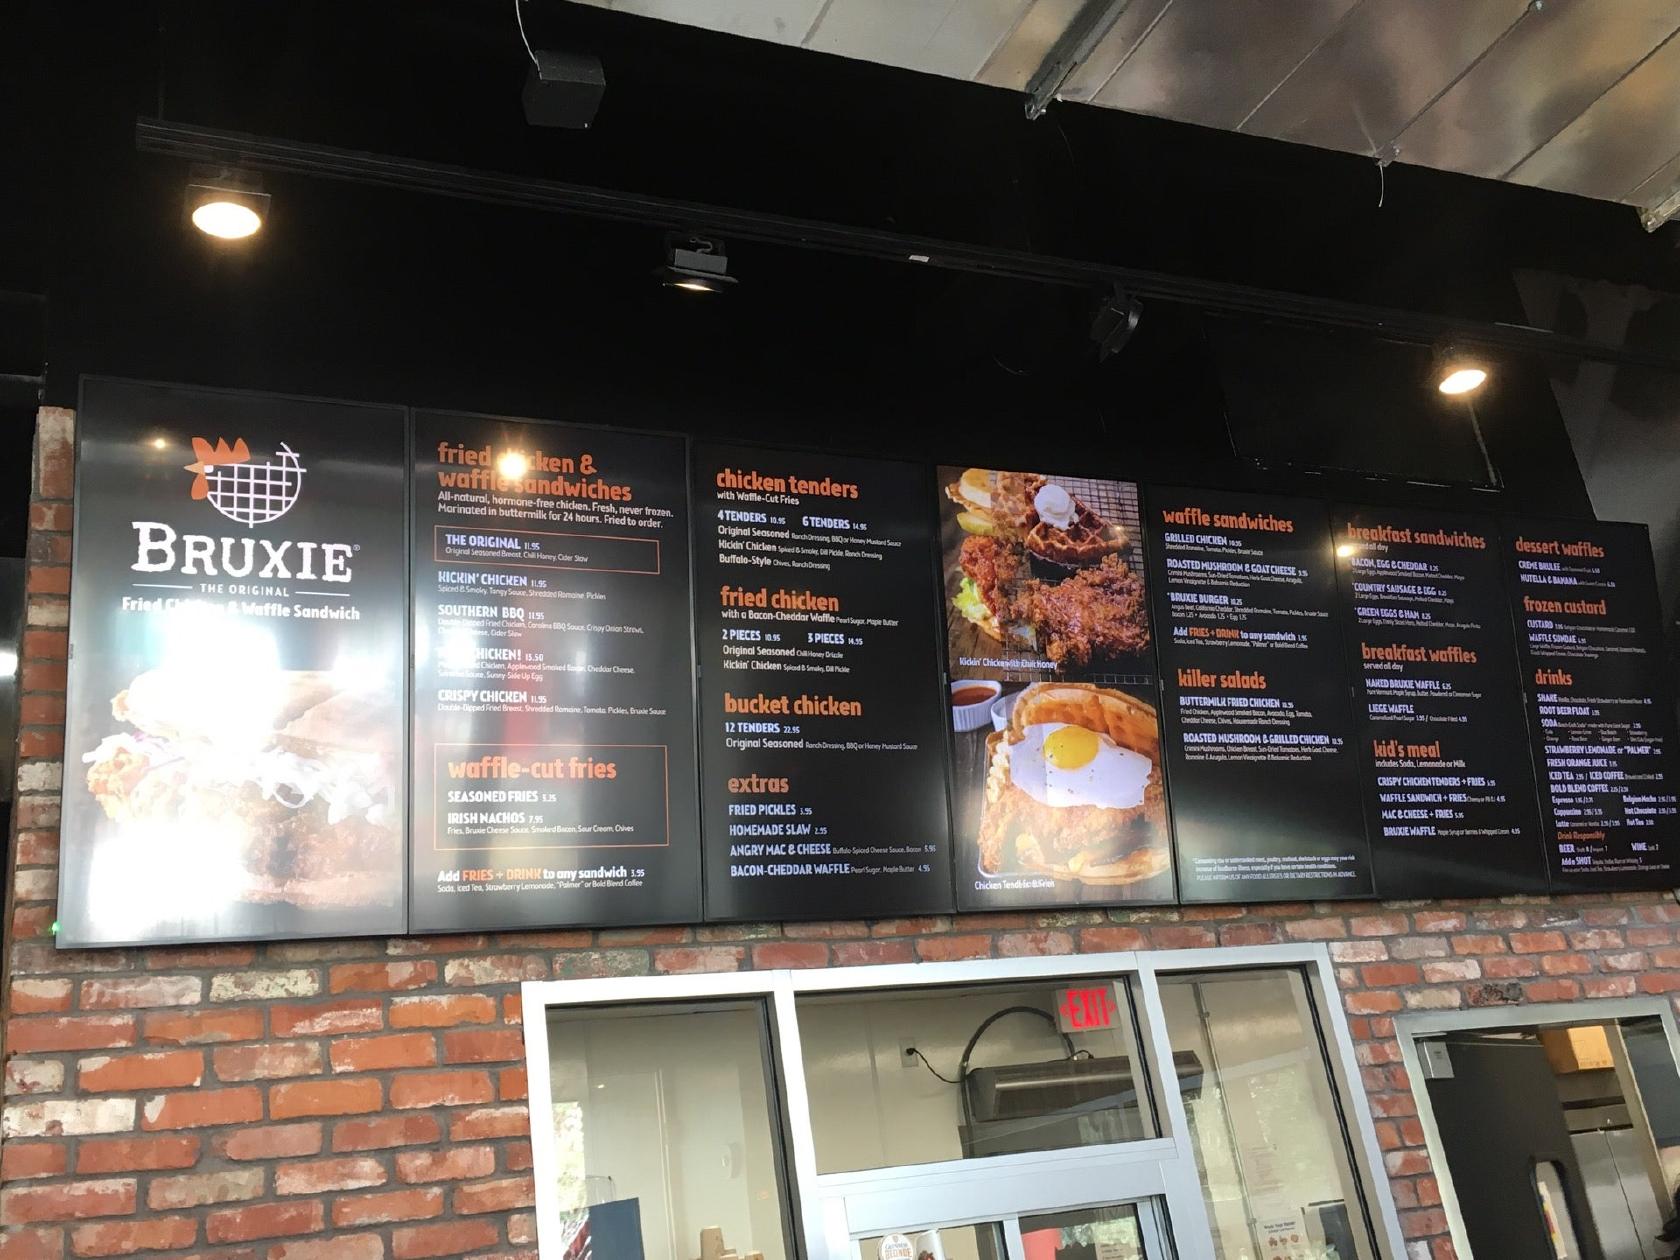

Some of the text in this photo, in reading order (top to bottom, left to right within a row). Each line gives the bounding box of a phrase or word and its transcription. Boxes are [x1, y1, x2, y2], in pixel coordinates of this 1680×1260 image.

[438, 442, 597, 475] fried &
[438, 469, 632, 501] waffle sandwiches
[717, 468, 858, 498] chicken tenders
[438, 491, 674, 517] All-natural, hormone-free chicken. Fresh, never frozen.
[717, 491, 799, 505] with Waffle-Cut Fries
[438, 503, 663, 528] Marinated in buttermilk for 24 hours. Fried to order.
[717, 510, 850, 529] 4 TENDERS 6 TENDERS
[1162, 508, 1293, 532] waffle sandwiches
[718, 526, 789, 539] Original Seasoned
[1165, 533, 1227, 545] GRILLED CHICKEN
[1347, 523, 1486, 549] breakfast sandwiches
[446, 534, 466, 545] THE
[468, 535, 520, 549] ORIGINAL
[746, 541, 777, 552] Chicken
[1515, 536, 1604, 557] dessert waffles
[131, 522, 352, 582] BRUXIE
[719, 554, 771, 566] Buffalo-Style
[1167, 559, 1242, 572] ROASTED MUSHROOM
[1377, 560, 1390, 568] EGG
[438, 571, 547, 588] KICKIN' CHICKEN 11.95
[200, 584, 289, 597] THE ORIGINAL
[721, 585, 839, 611] fried chicken
[1199, 594, 1228, 604] BURGER
[122, 597, 162, 611] Fried
[241, 602, 290, 617] Waffle
[294, 605, 360, 620] Sandwich
[1523, 596, 1606, 615] frozen custard
[438, 605, 497, 618] SOUTHERN
[502, 606, 524, 620] BBQ
[722, 609, 739, 618] with
[748, 610, 809, 622] Bacon-Cheddar
[810, 613, 835, 623] Waffle
[1527, 620, 1553, 628] CUSTARD
[722, 629, 844, 644] 2 PIECES 3 PIECES
[1173, 627, 1188, 636] Add
[1250, 631, 1262, 640] any
[1264, 630, 1296, 640] sandwich
[723, 646, 795, 657] Original Seasoned
[1362, 642, 1477, 663] breakfast waffles
[751, 660, 781, 670] Chicken
[1178, 668, 1266, 689] killer salads
[1535, 669, 1572, 685] drinks
[1390, 679, 1440, 689] BRUXIE WAFFLE
[438, 690, 478, 702] CRISPY
[480, 691, 527, 703] CHICKEN
[1180, 697, 1280, 708] BUTTERMILK FRIED CHICKEN
[725, 693, 861, 716] bucket chicken
[1388, 705, 1414, 713] WAFFLE
[725, 723, 780, 733] 12 TENDERS
[726, 738, 803, 750] Original Seasoned
[1184, 733, 1329, 744] ROASTED MUSHROOM GRILLED CHICKEN
[1374, 739, 1440, 758] kid's meal
[448, 756, 617, 779] waffle-cut fries
[728, 774, 789, 793] extras
[1378, 777, 1401, 786] CRISPY
[1403, 778, 1431, 786] CHICKEN
[1431, 778, 1460, 786] TENDERS
[448, 791, 538, 802] SEASONED FRIES
[1380, 794, 1406, 802] WAFFLE
[1407, 794, 1442, 802] SANDWICH
[1449, 794, 1467, 802] FRIES
[729, 805, 796, 815] FRIED PICKLES
[448, 812, 525, 824] IRISH NACHOS
[730, 824, 811, 836] HOMEMADE SLAW
[1410, 827, 1436, 835] WAFFLE
[730, 844, 831, 856] ANGRY MAC CHEESE
[438, 866, 644, 882] Add FRIES DRINK to any sandwich 3.95
[730, 864, 850, 876] BACON-CHEDDAR WAFFLE
[1068, 988, 1111, 1028] EXIT
